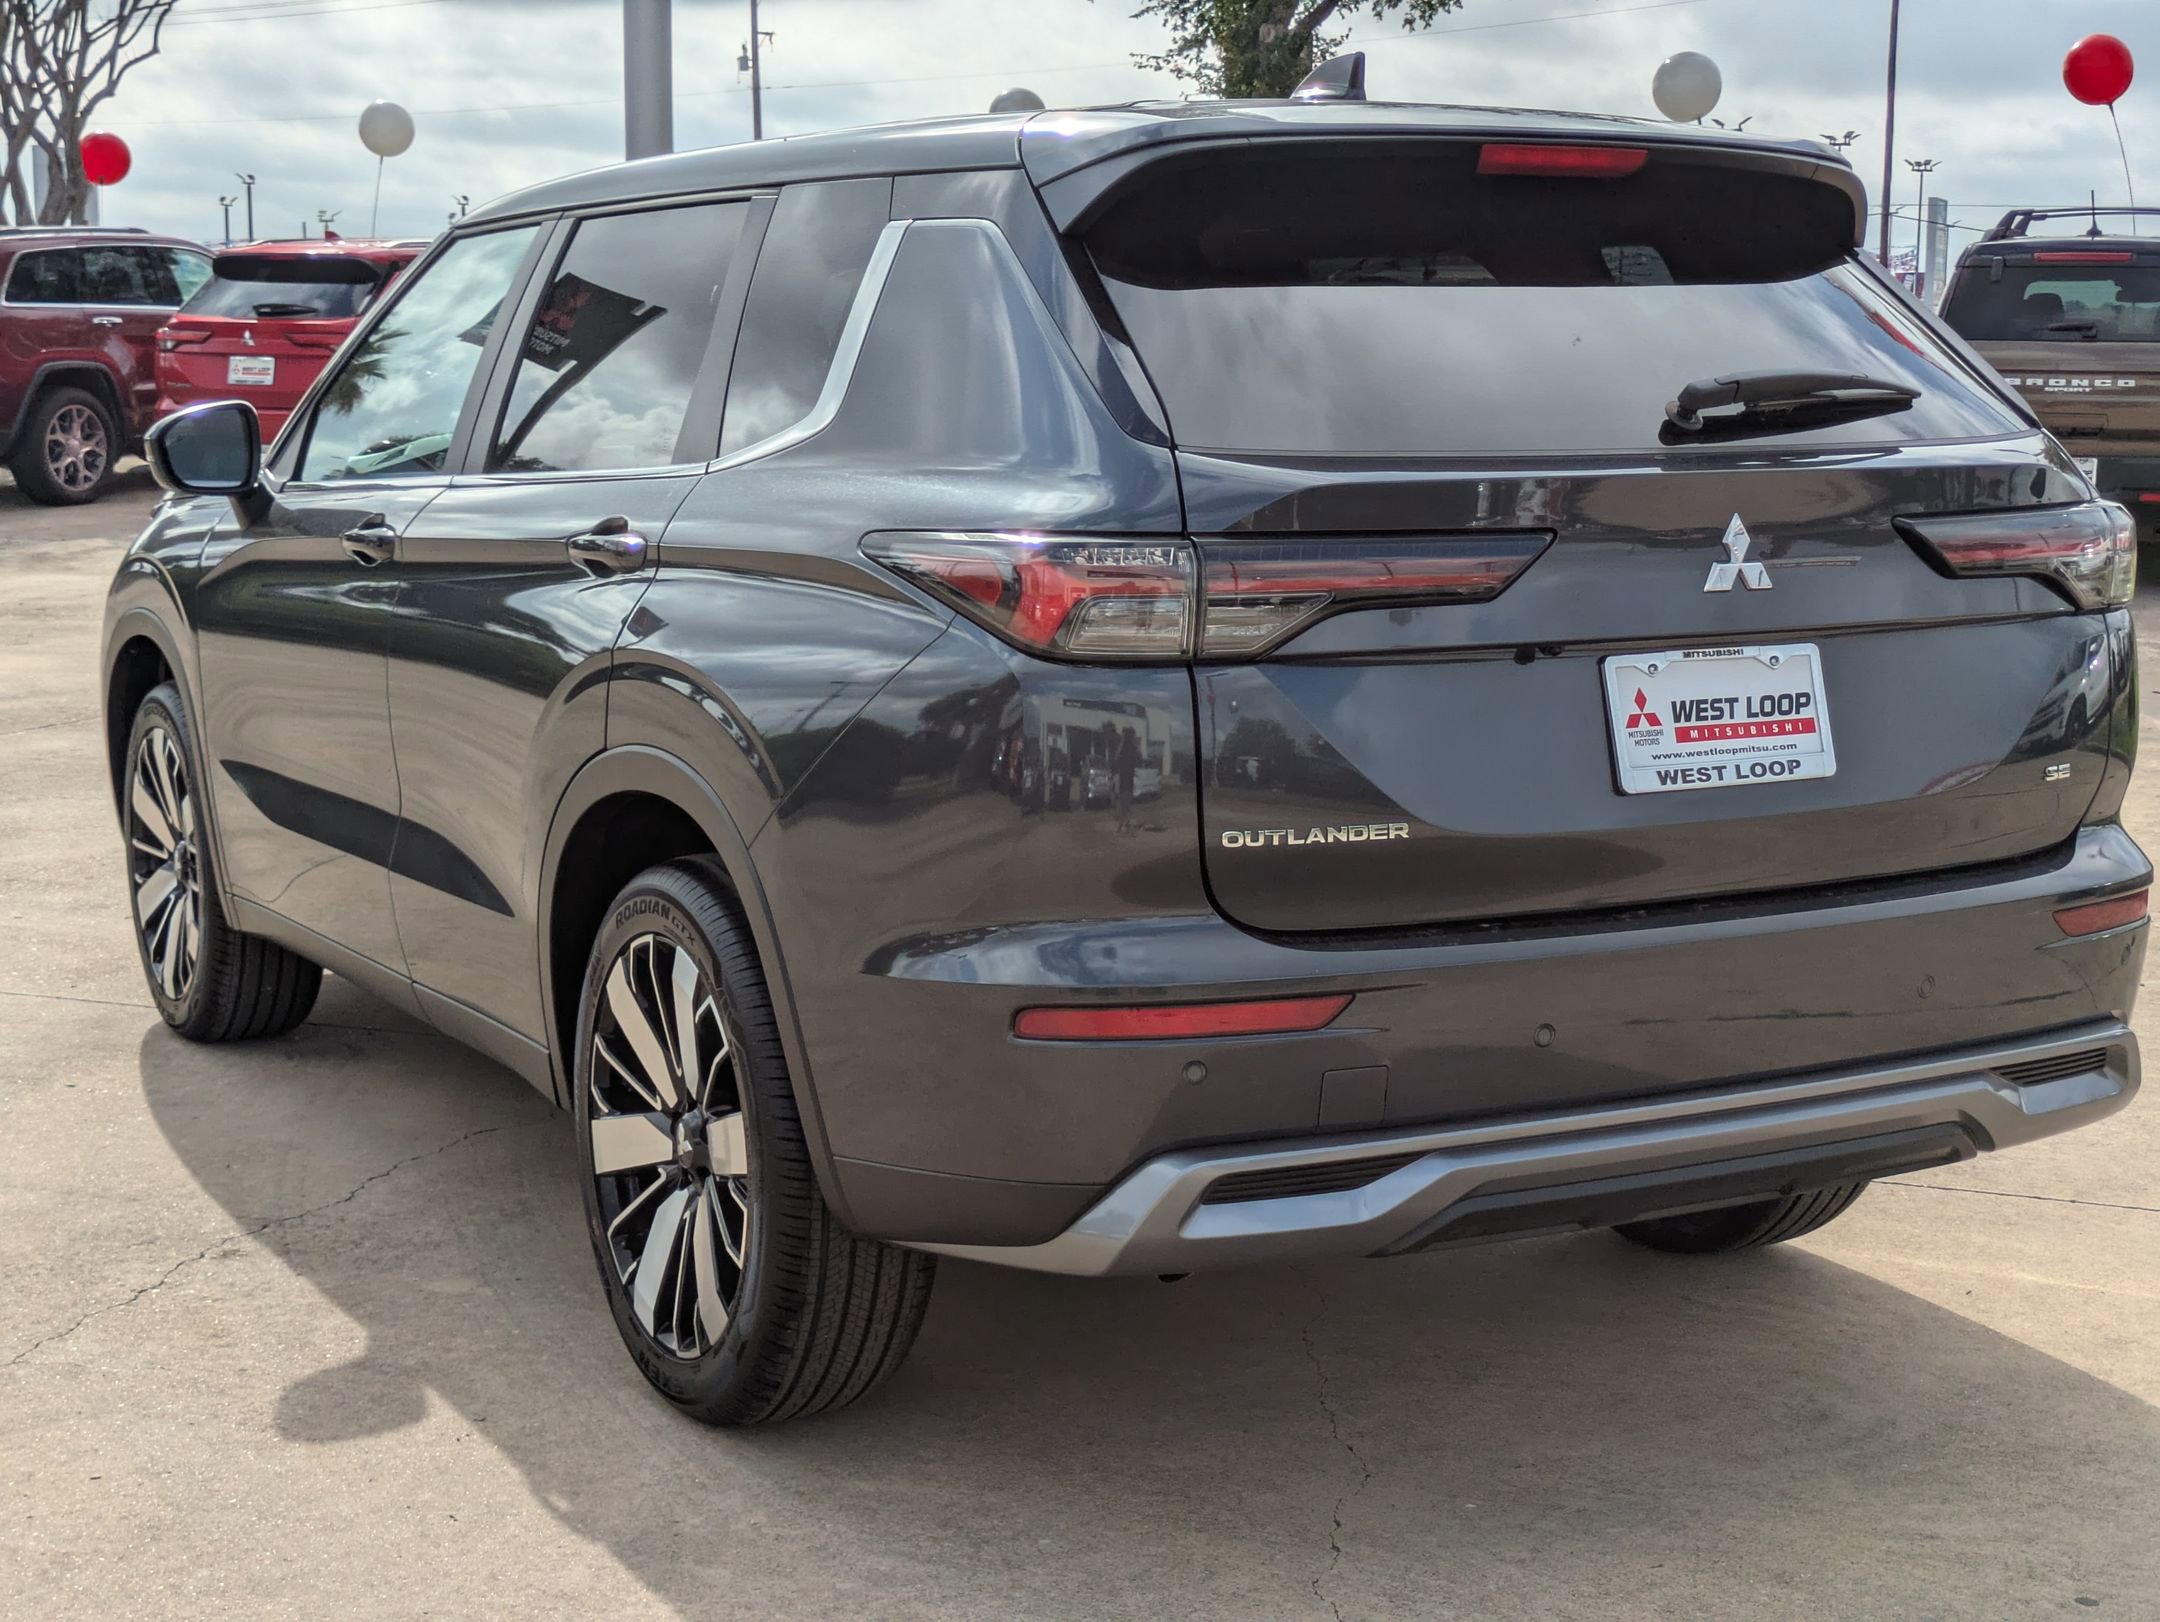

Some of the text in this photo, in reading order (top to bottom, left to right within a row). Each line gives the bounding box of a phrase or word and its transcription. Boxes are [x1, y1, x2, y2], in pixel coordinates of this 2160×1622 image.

[2003, 377, 2136, 387] BRONCO
[1682, 648, 1744, 659] MITSUBISHI
[1671, 692, 1811, 724] WEST LOOP
[1628, 729, 1664, 739] MITSUBISHI
[1690, 722, 1803, 739] MITSUBISHI
[1634, 738, 1660, 747] MOTORS
[1651, 742, 1797, 761] www.westloopmitsu.com
[1656, 759, 1802, 786] WEST LOOP
[2044, 763, 2071, 782] SE
[1221, 822, 1410, 848] OUTLANDER
[615, 899, 671, 930] ROADIAN
[671, 915, 697, 946] GTX
